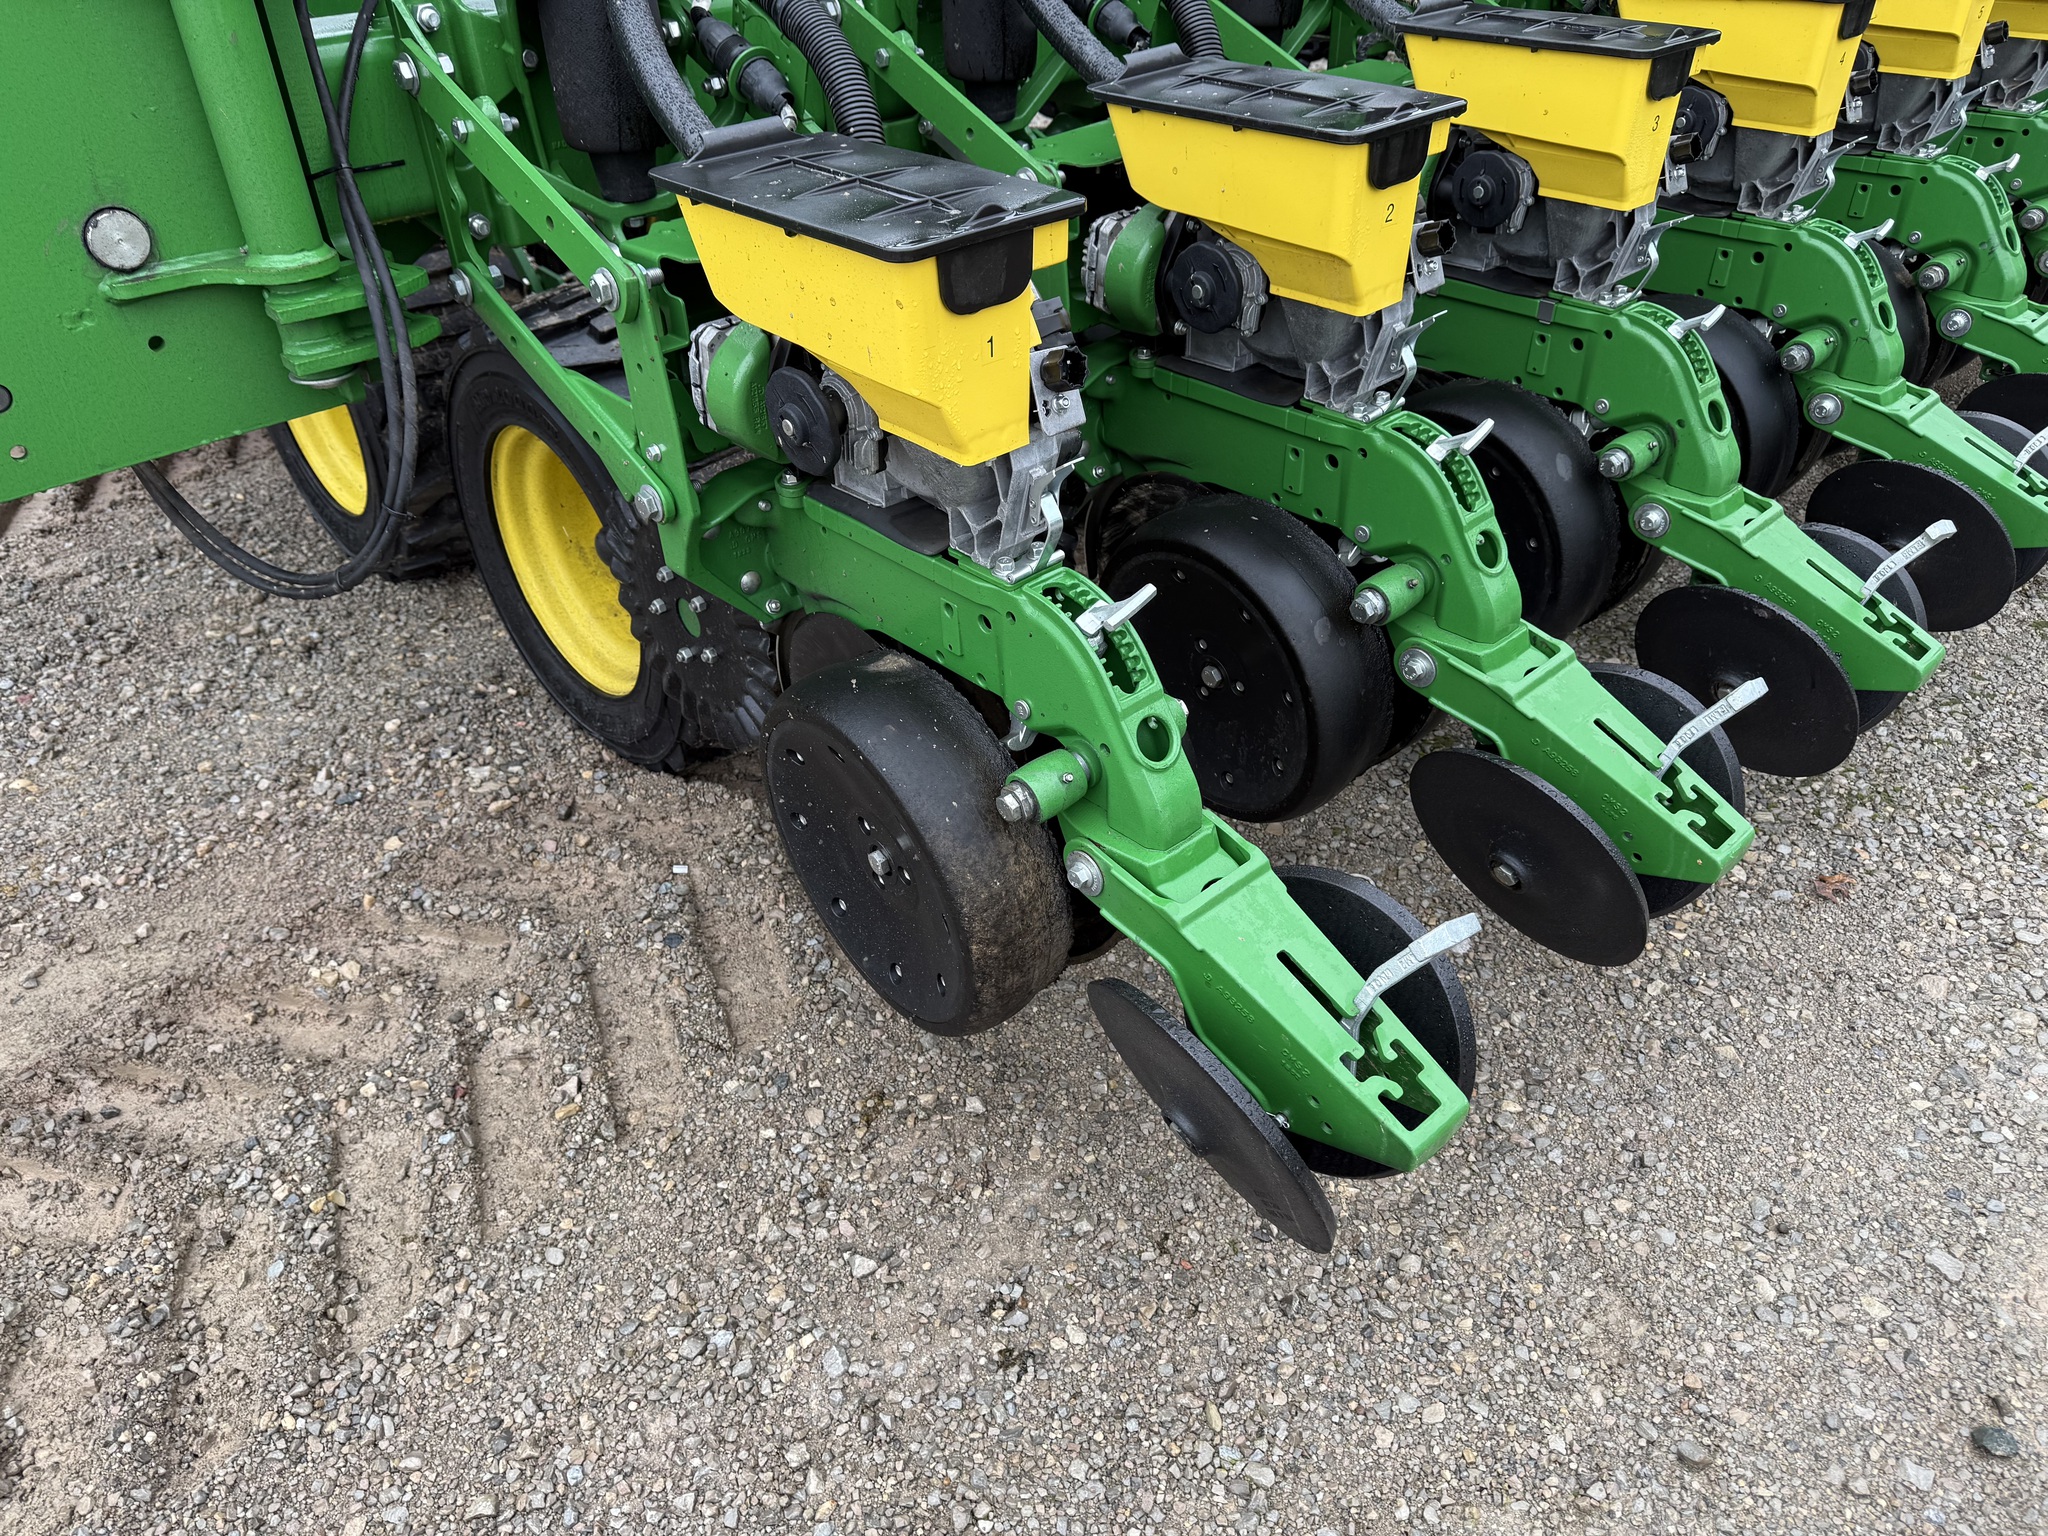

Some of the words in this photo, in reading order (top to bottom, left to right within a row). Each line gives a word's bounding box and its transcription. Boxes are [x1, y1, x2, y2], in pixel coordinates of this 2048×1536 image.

[1977, 5, 1985, 19] 5
[1839, 51, 1846, 66] 4
[1651, 114, 1661, 132] 3
[1385, 203, 1395, 223] 2
[986, 335, 994, 358] 1
[1541, 746, 1580, 778] A93258
[1215, 984, 1256, 1025] A93258
